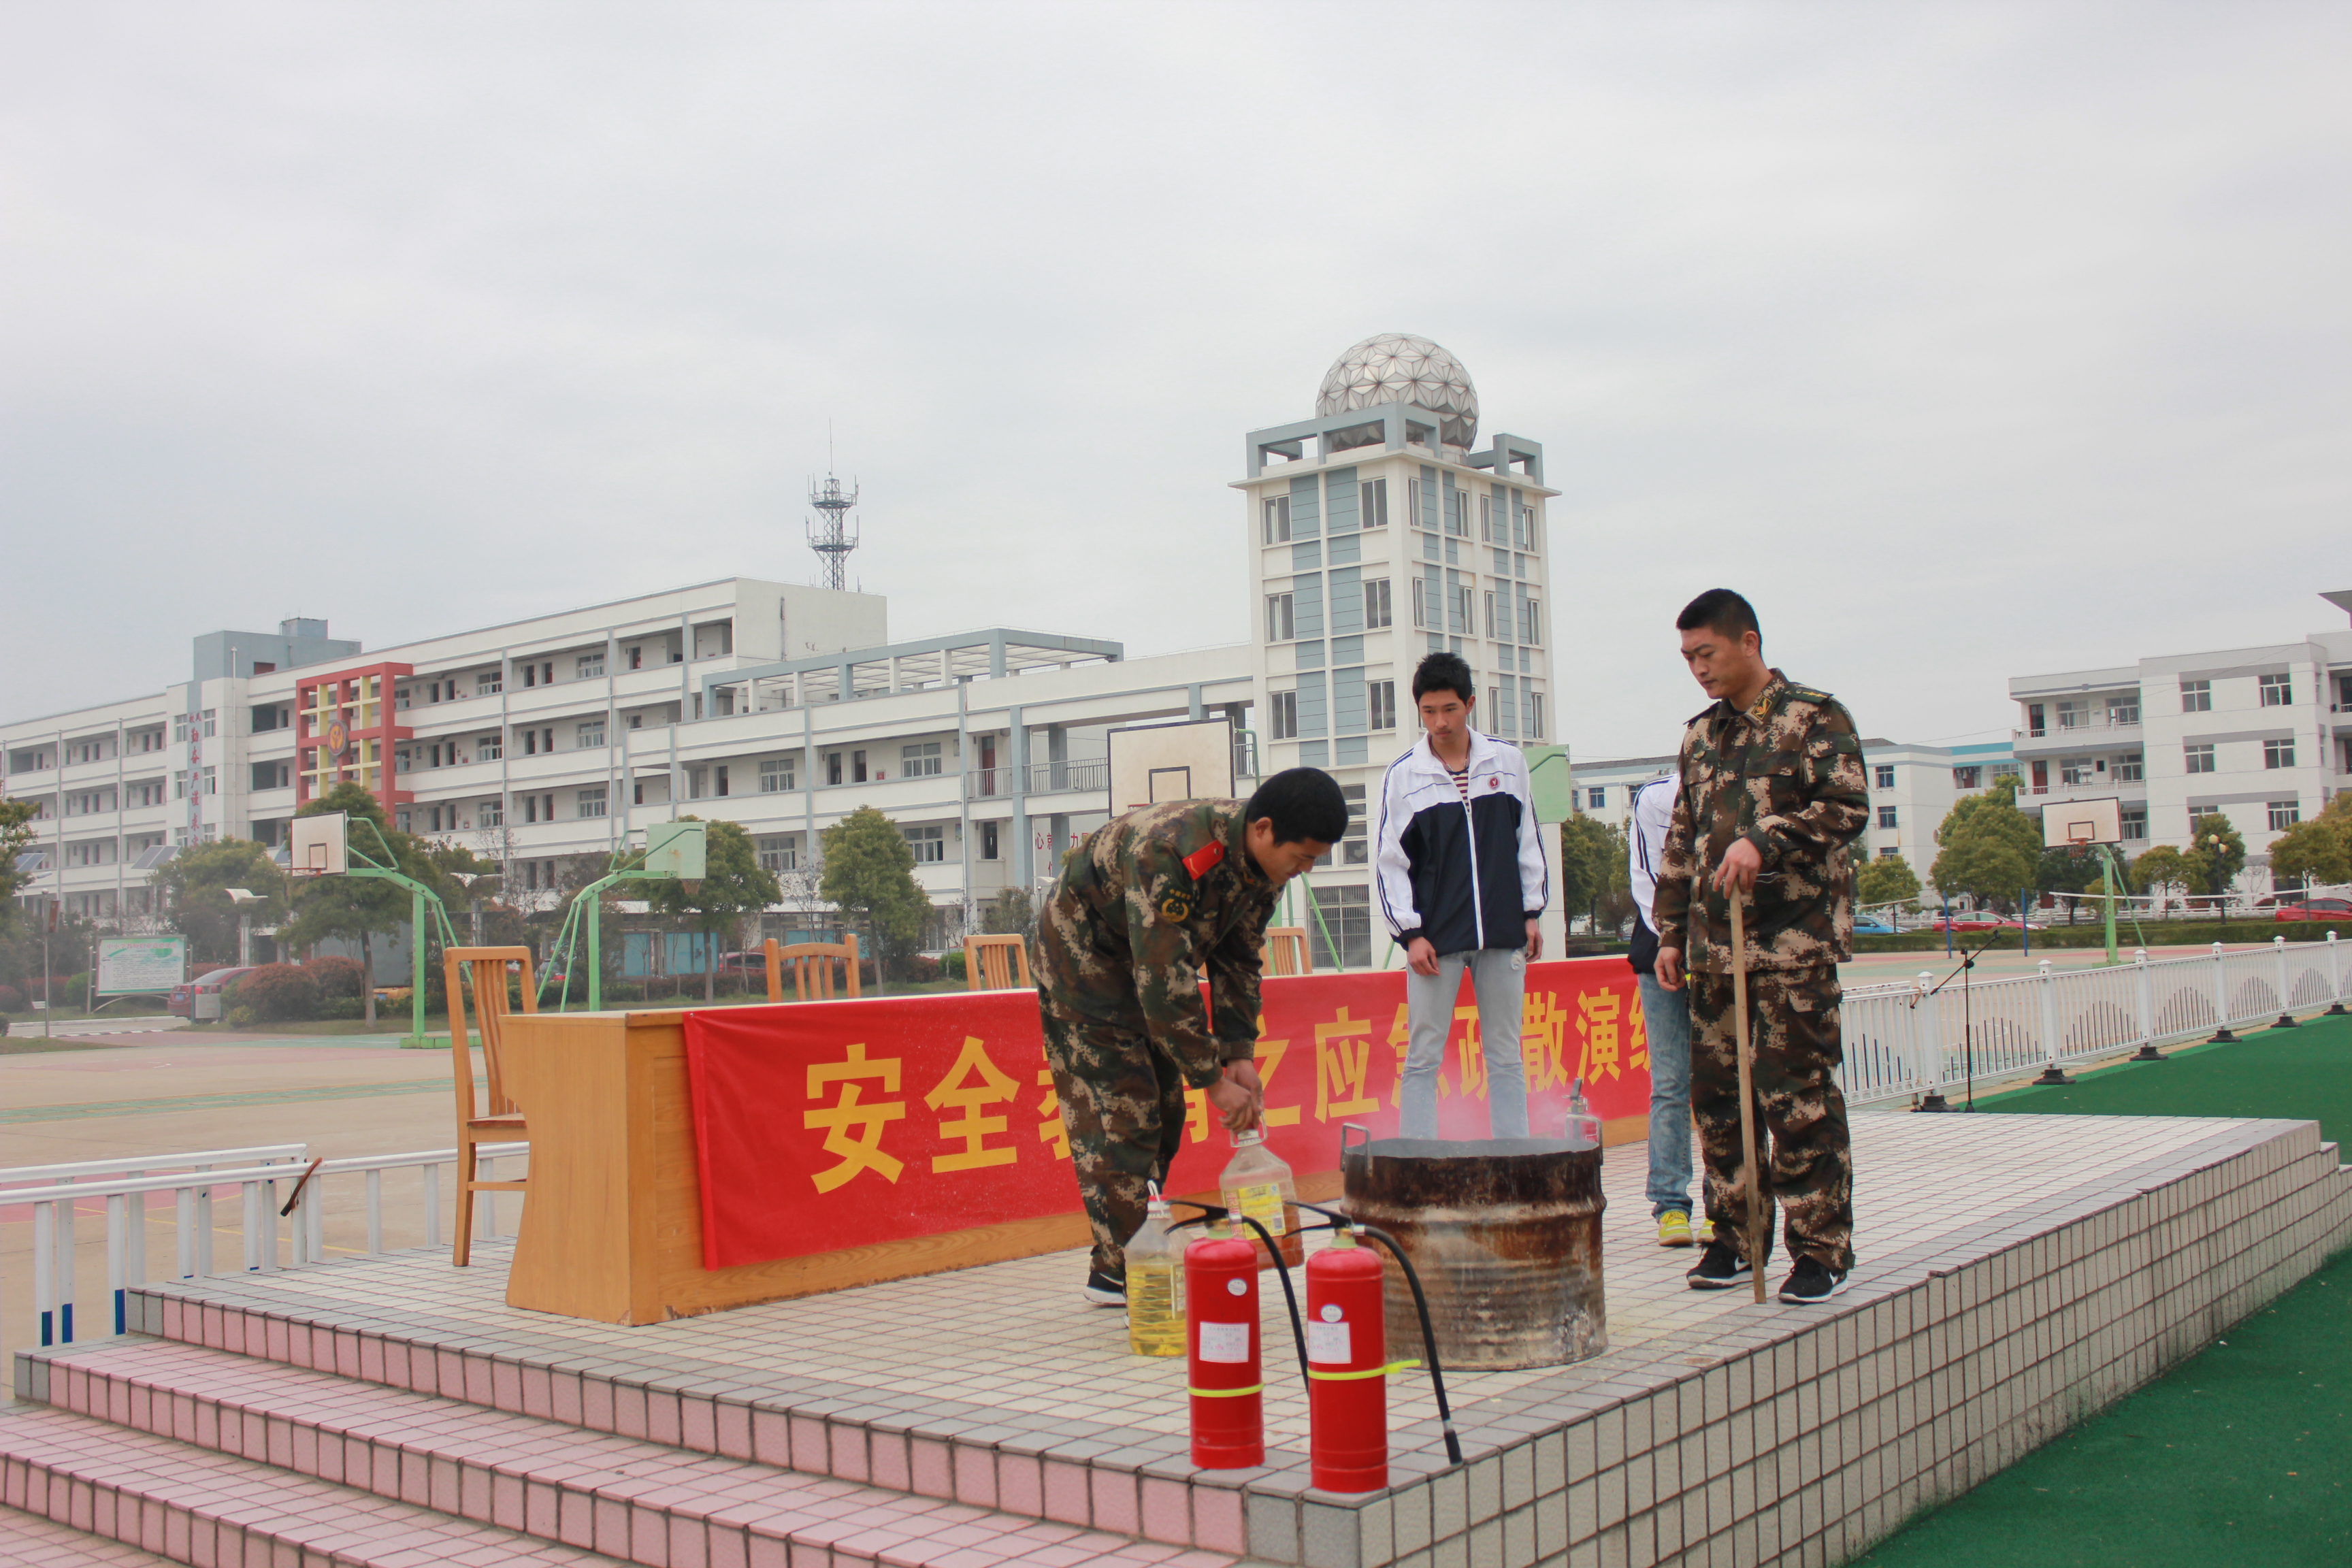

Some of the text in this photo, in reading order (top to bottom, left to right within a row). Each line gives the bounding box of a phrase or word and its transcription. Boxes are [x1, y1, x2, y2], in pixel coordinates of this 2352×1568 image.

[804, 985, 1650, 1194] 安全之应疏散演
